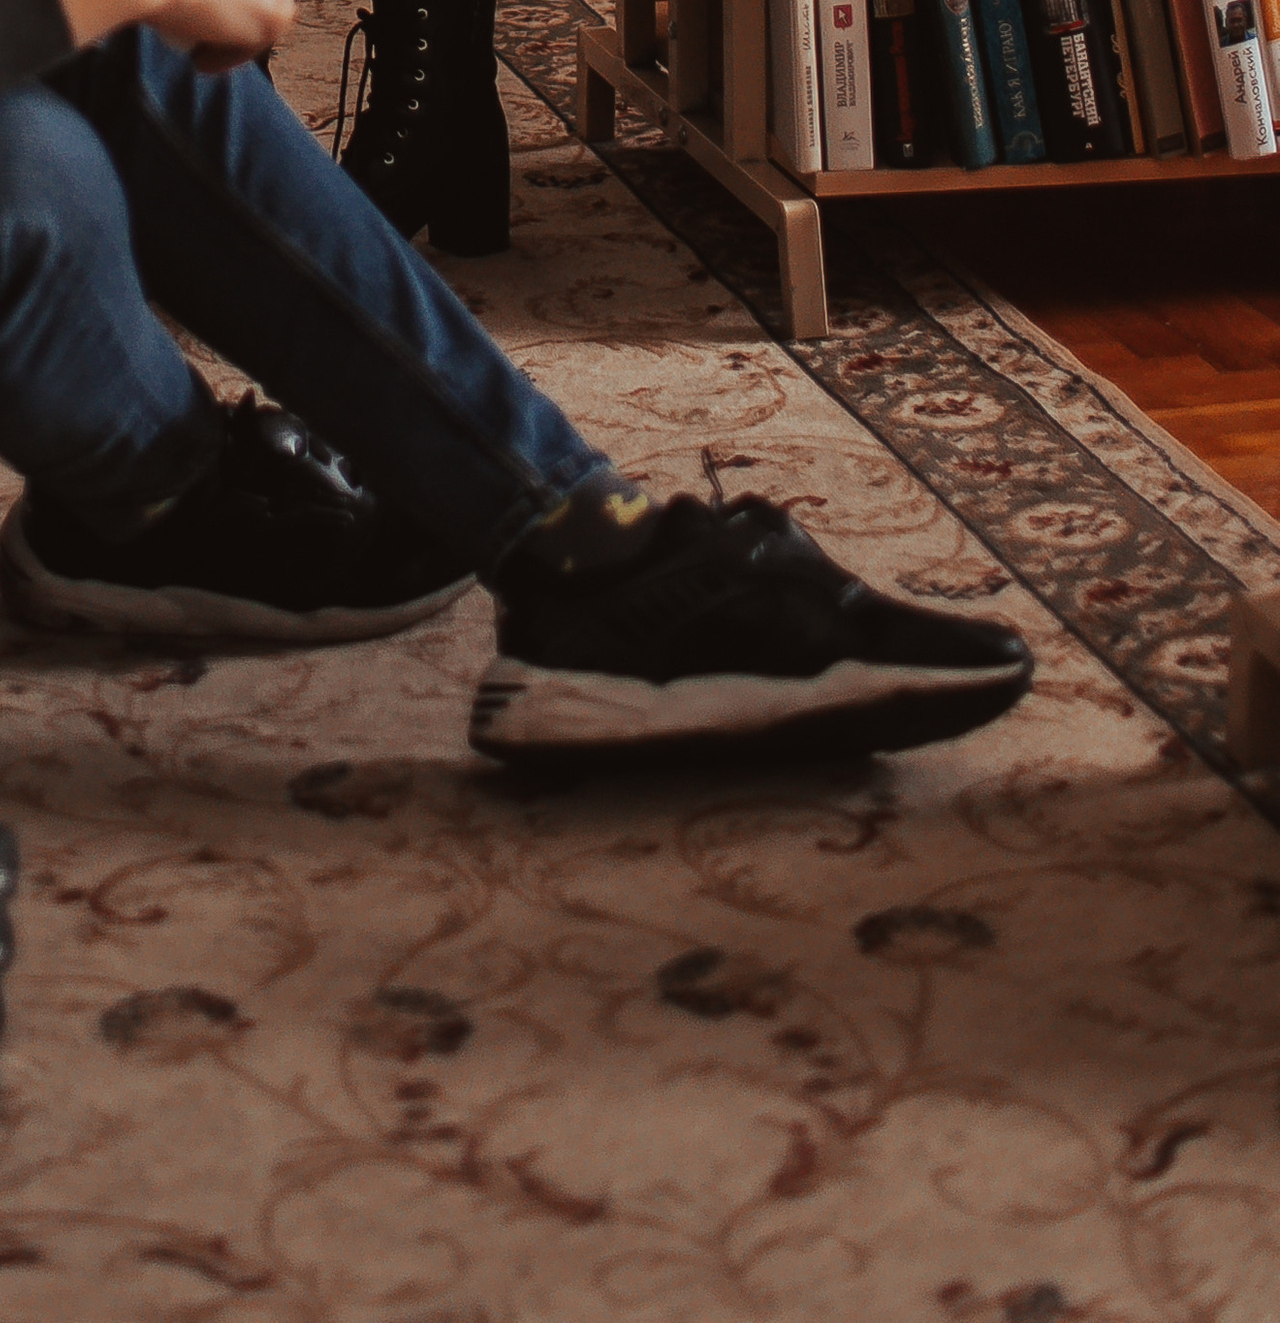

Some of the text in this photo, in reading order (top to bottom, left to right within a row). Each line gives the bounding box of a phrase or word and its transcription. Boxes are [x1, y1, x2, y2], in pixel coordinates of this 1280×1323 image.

[834, 41, 847, 107] ВЛАДИМИР
[1060, 36, 1085, 118] ПЕТЕРБУРГ
[1073, 32, 1101, 126] БАНДИТСКИЙ
[1230, 50, 1246, 104] Андрей
[1244, 46, 1268, 147] Кончаловский
